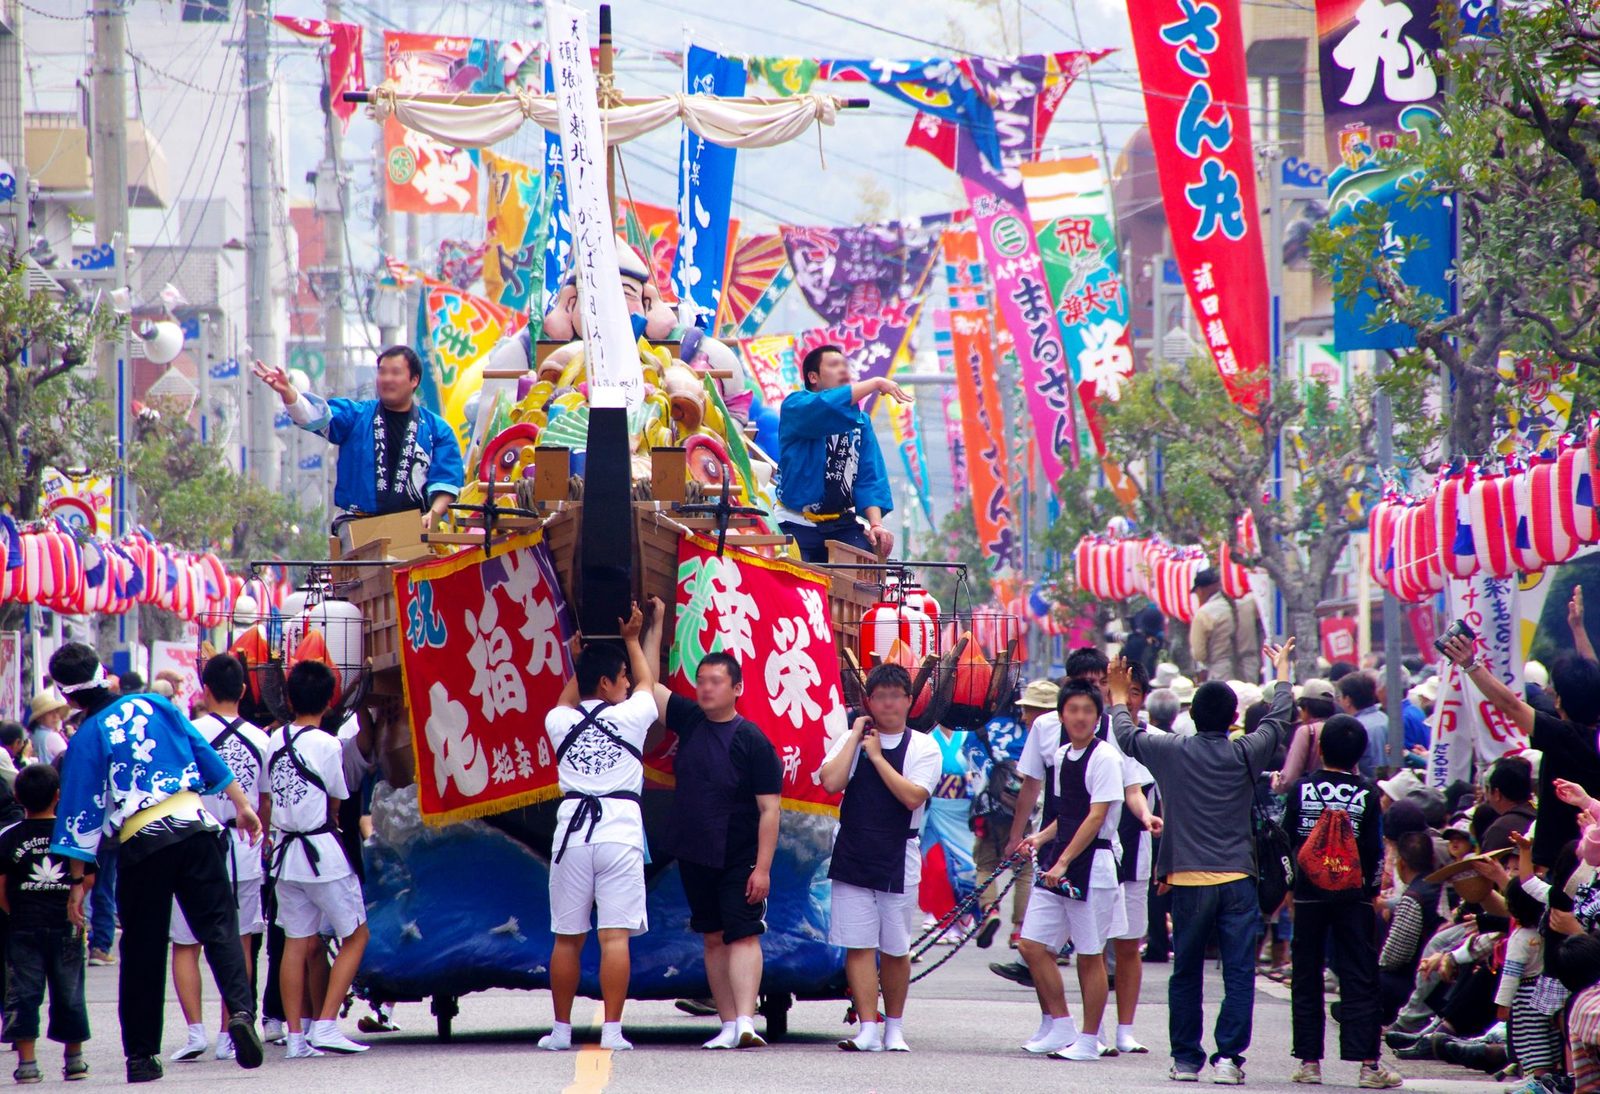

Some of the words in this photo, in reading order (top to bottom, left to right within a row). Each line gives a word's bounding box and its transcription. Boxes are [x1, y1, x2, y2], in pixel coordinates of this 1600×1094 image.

[1332, 0, 1438, 106] 丸
[1055, 218, 1098, 257] 祝
[1080, 319, 1134, 401] 栄
[373, 415, 388, 491] 牛深ハイヤ祭
[394, 421, 418, 494] 熊本県牛深市
[407, 576, 448, 653] 祝
[797, 587, 832, 644] 祝
[120, 699, 157, 763] ハイヤ
[1301, 781, 1370, 808] ROCK
